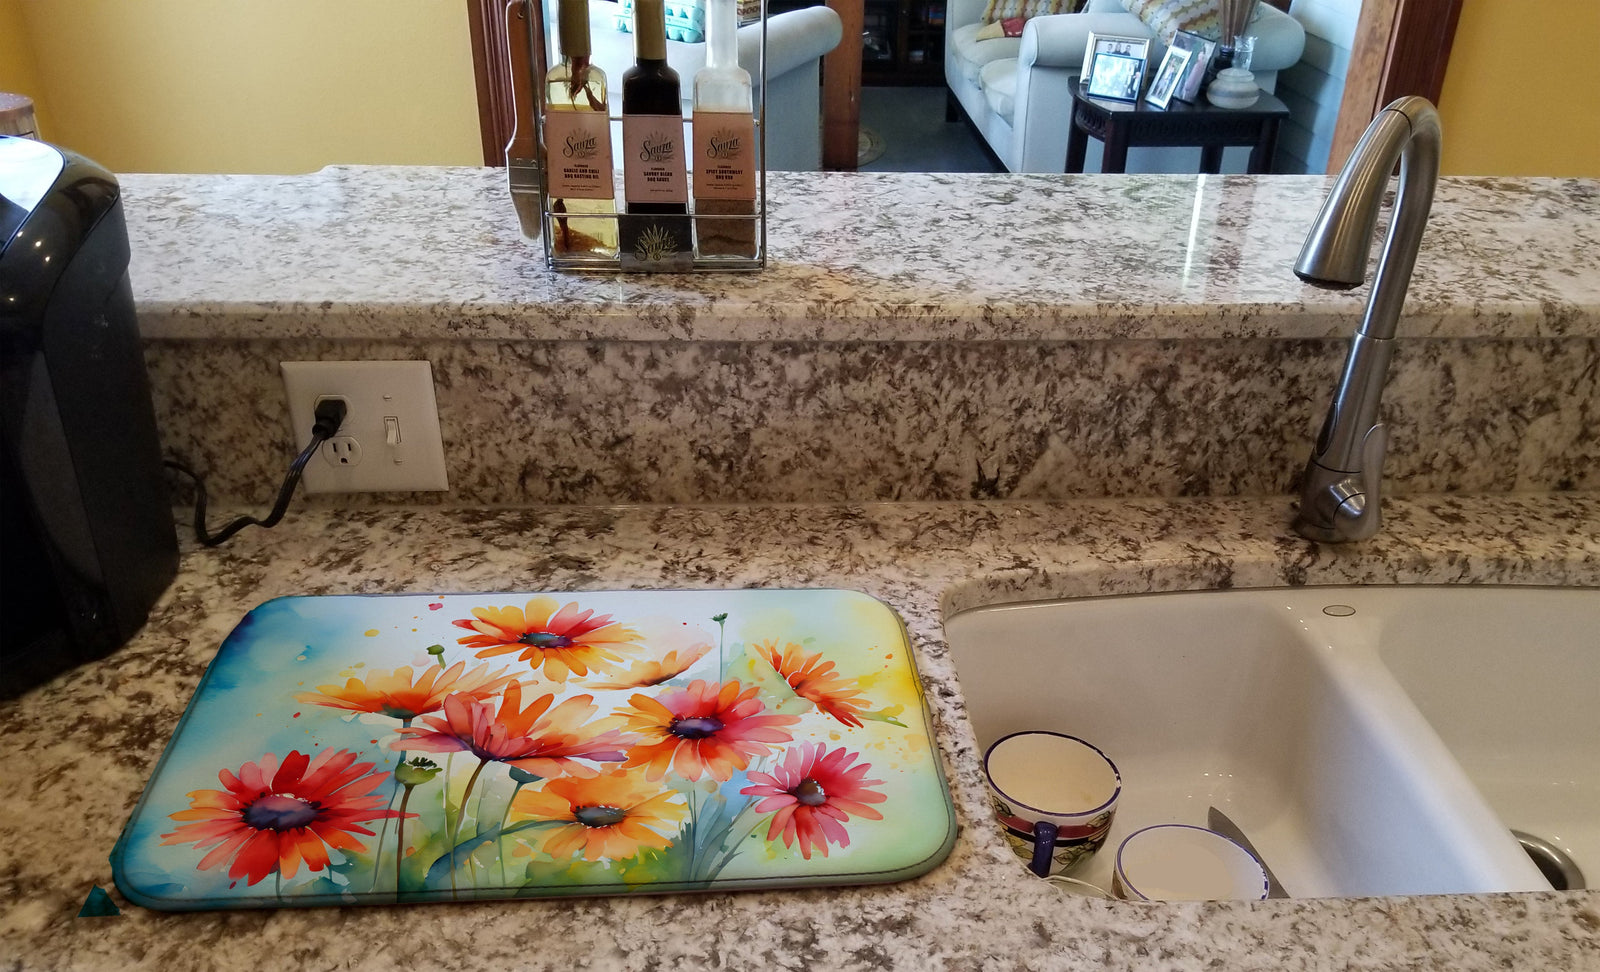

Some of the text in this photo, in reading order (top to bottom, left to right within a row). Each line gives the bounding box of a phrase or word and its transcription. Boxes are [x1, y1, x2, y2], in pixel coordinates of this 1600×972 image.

[563, 136, 597, 158] Sauza
[640, 140, 673, 162] Sauza
[707, 137, 740, 159] Sauza
